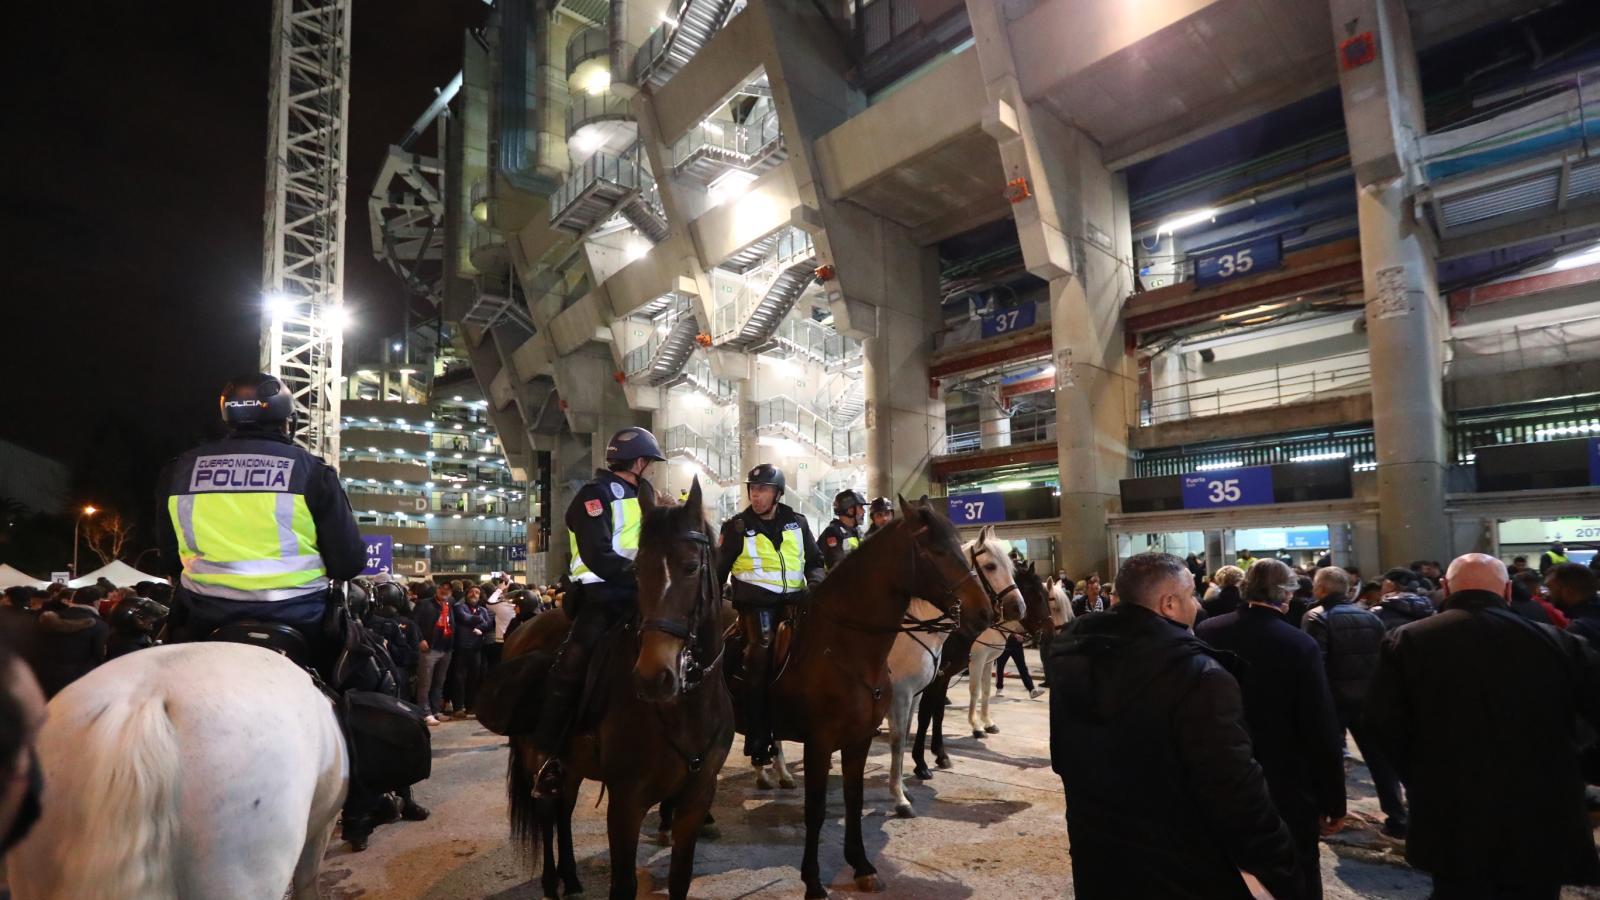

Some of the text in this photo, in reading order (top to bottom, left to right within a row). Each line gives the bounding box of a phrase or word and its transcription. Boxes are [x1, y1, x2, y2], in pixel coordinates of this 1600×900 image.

[1218, 249, 1254, 277] 35
[996, 310, 1019, 332] 37
[224, 400, 262, 408] POLICIA
[198, 459, 234, 468] CUERPO
[235, 459, 275, 468] NACIONAL
[194, 469, 286, 487] POLICIA
[1208, 479, 1241, 503] 35
[415, 498, 427, 511] D
[964, 501, 985, 520] 37
[366, 557, 381, 568] 47
[414, 560, 427, 573] D
